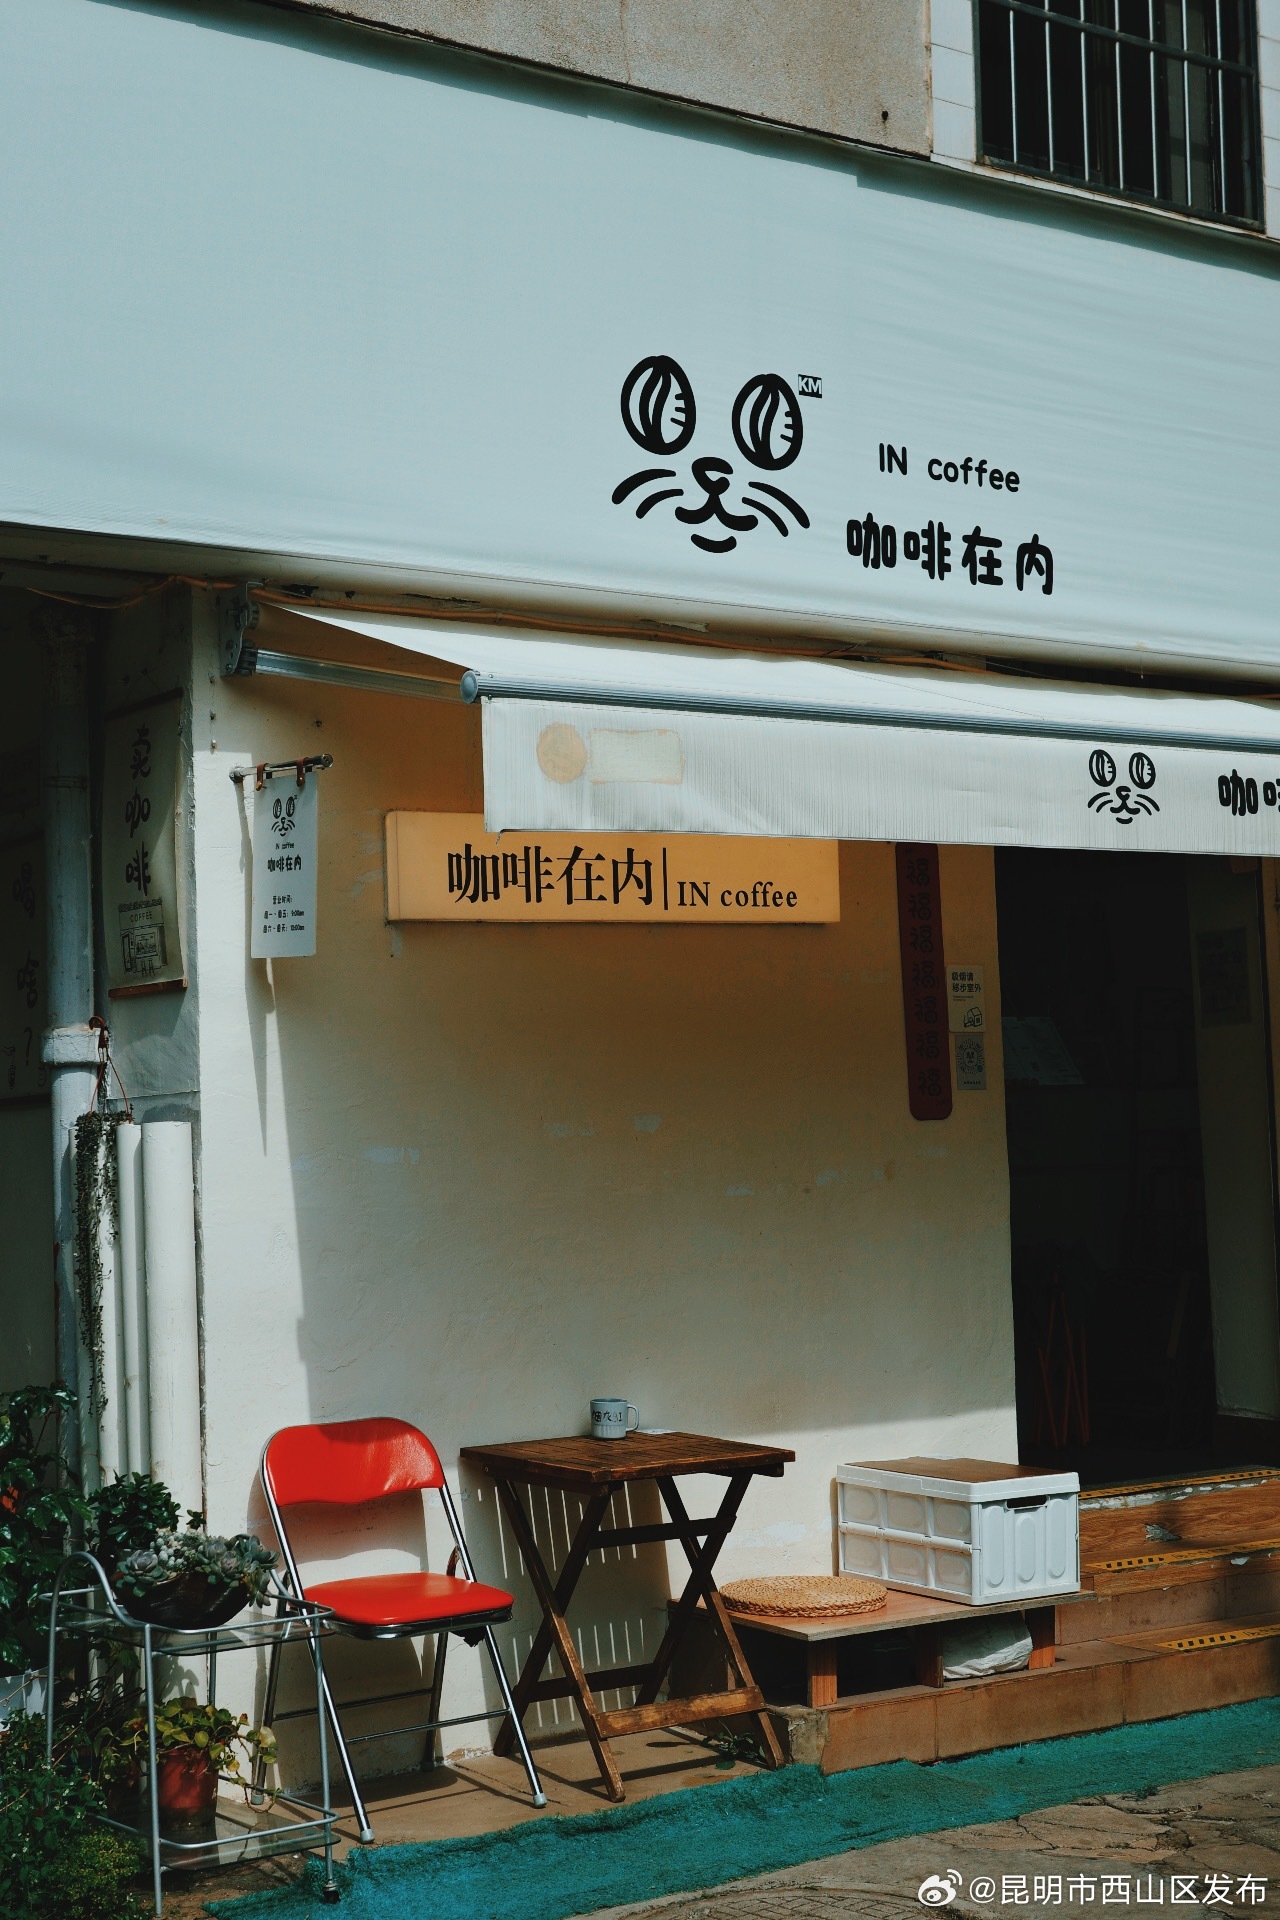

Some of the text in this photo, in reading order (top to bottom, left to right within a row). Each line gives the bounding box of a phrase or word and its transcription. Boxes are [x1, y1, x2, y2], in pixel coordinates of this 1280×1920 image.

[799, 376, 822, 396] KM
[879, 443, 1020, 492] IN coffee
[846, 512, 1054, 595] 咖啡在内
[267, 854, 302, 872] 咖啡在内
[447, 843, 798, 907] 咖啡在内 IN coffee
[130, 911, 153, 923] COFFEE
[952, 983, 982, 993] 移步室外
